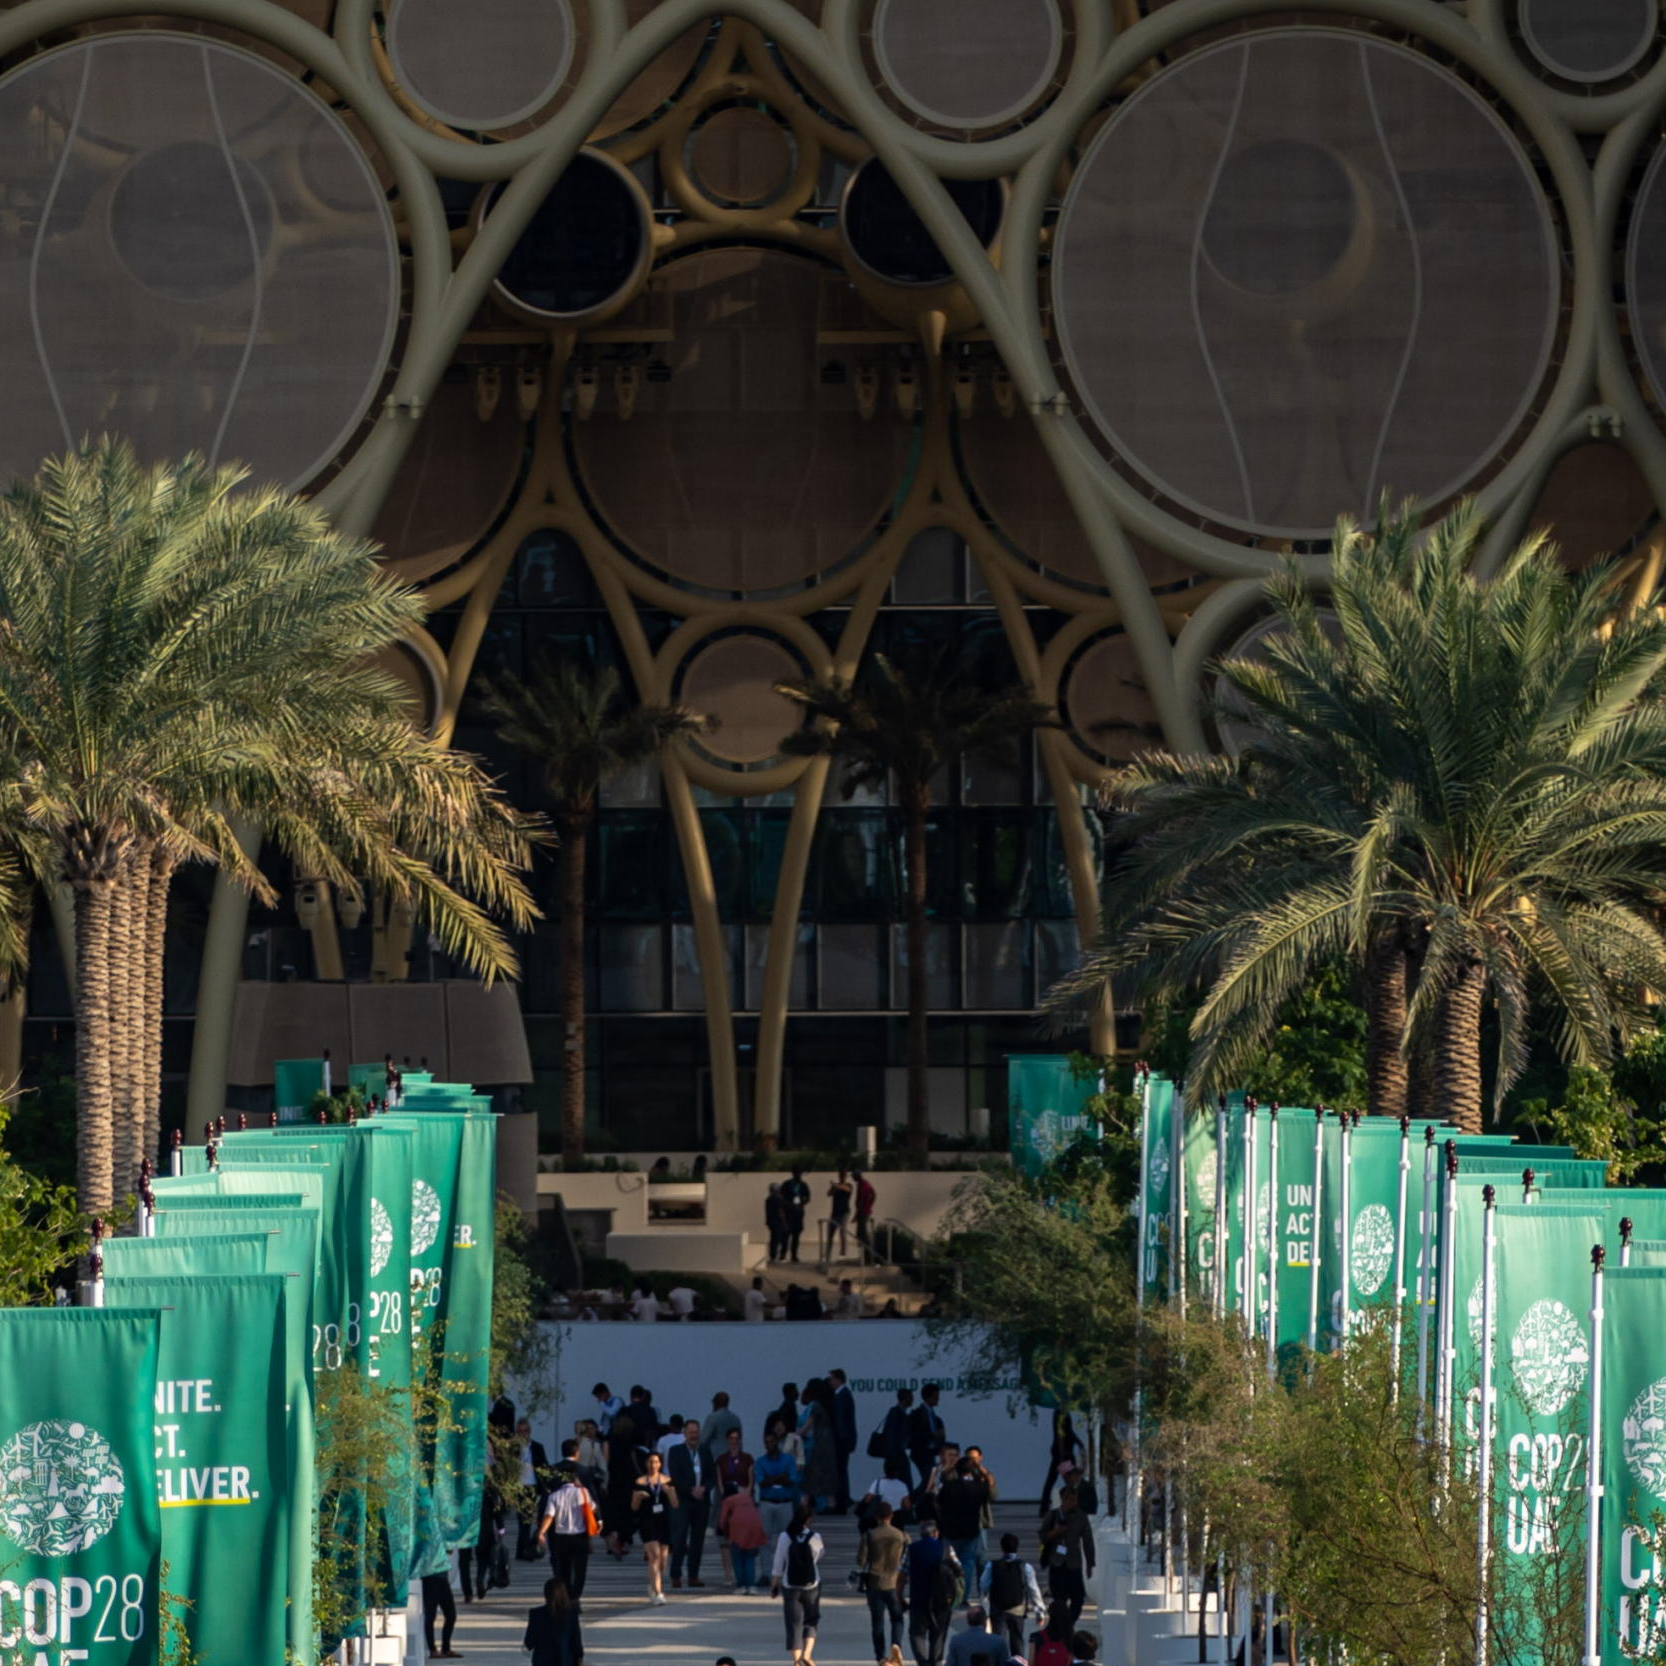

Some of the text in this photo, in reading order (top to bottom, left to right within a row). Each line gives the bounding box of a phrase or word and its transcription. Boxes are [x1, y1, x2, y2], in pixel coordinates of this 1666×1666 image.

[154, 1378, 222, 1414] NITE.
[850, 1378, 875, 1393] YOU
[877, 1377, 919, 1393] COULD
